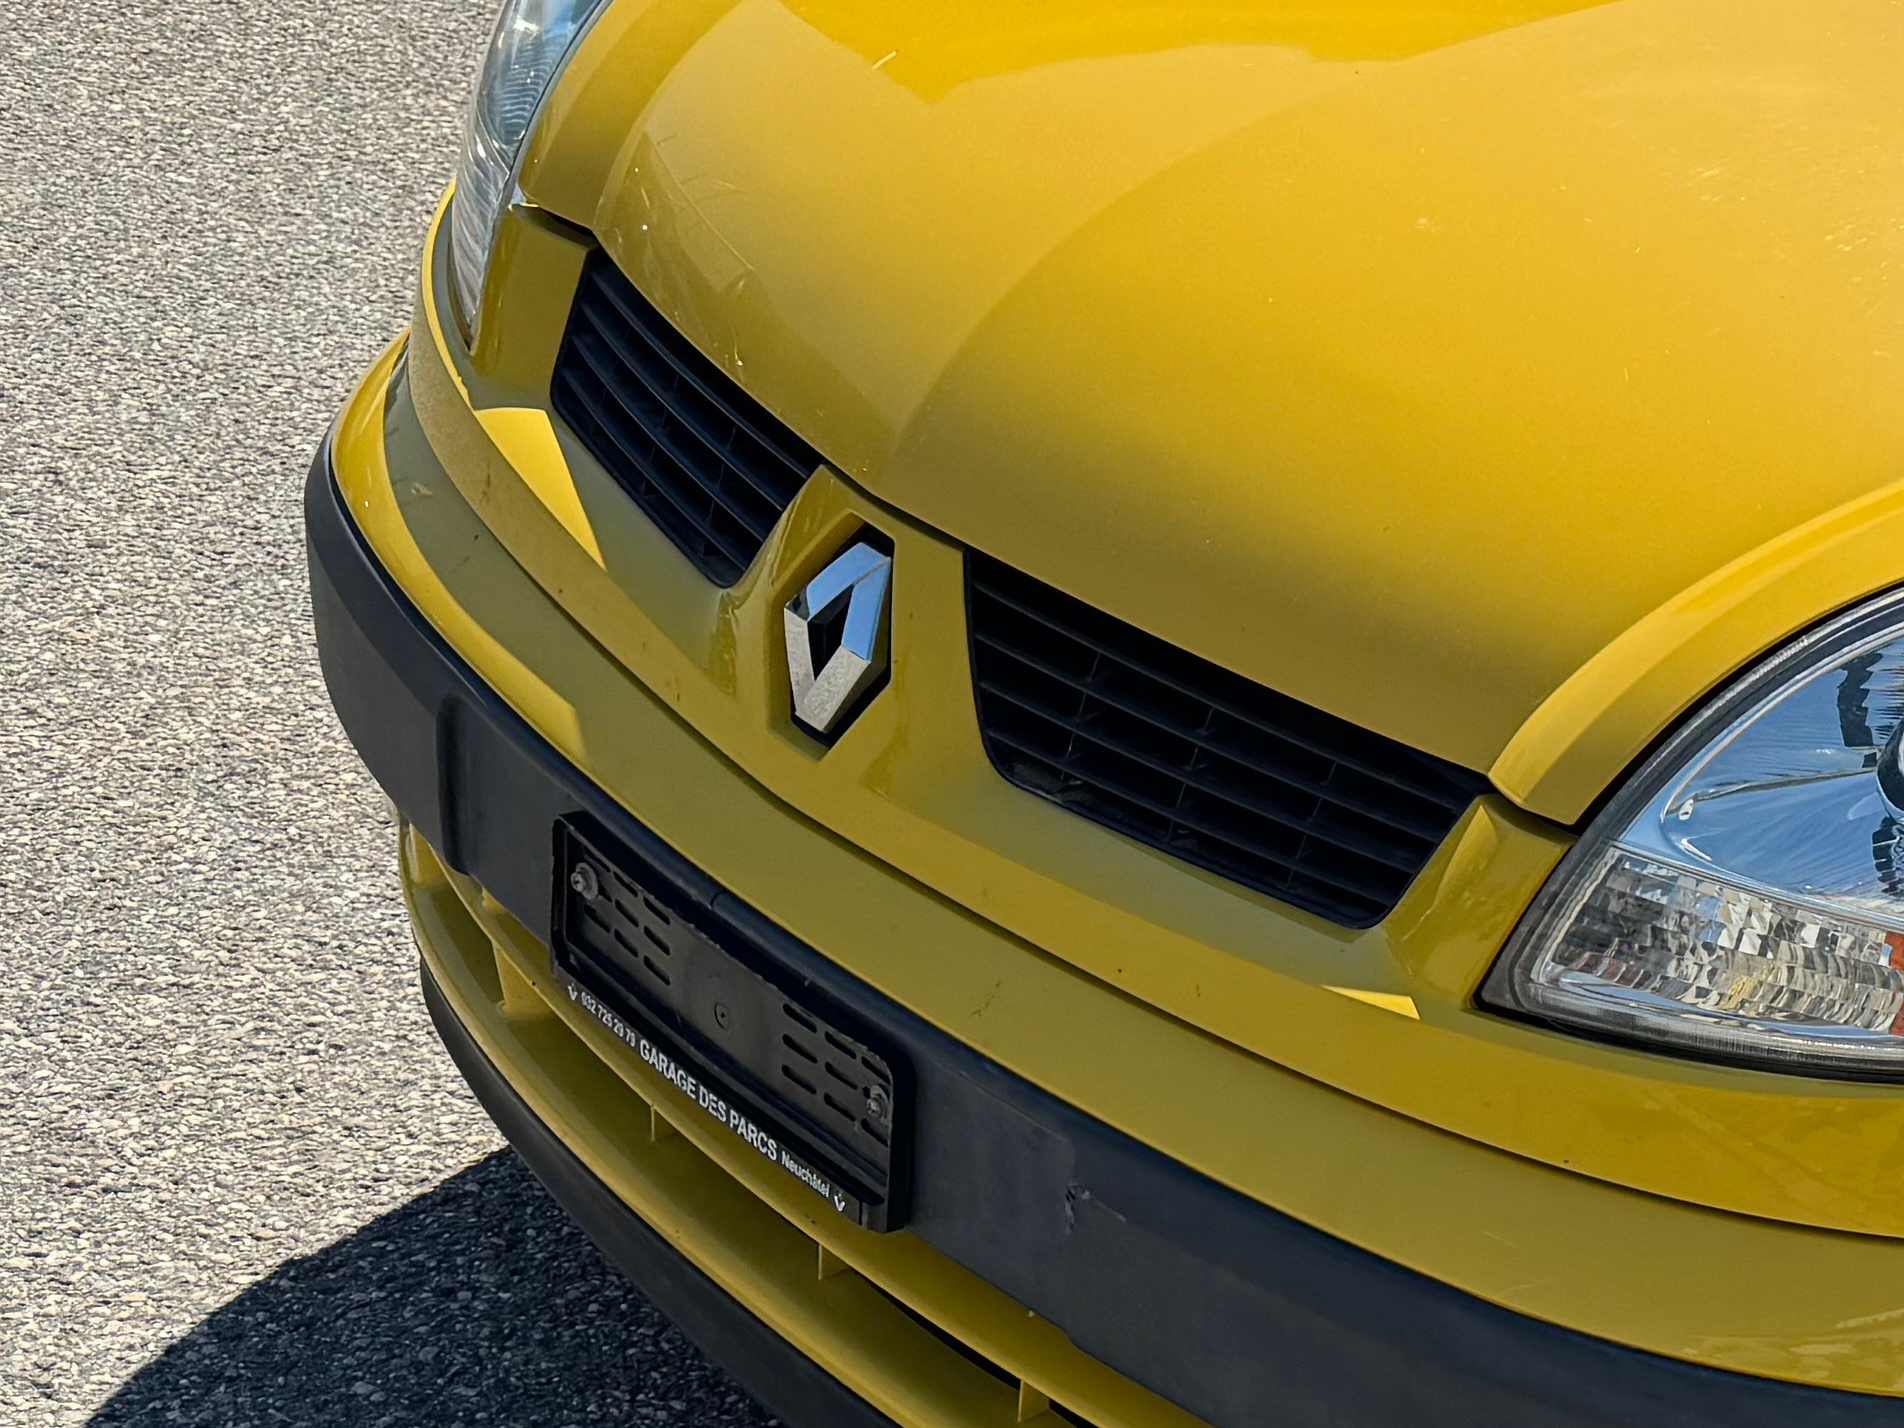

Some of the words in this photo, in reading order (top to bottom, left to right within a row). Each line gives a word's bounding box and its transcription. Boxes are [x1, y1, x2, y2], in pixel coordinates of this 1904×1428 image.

[640, 1039, 696, 1099] GARAGE
[699, 1085, 727, 1122] DES
[729, 1109, 777, 1160] PARCS
[781, 1150, 830, 1198] Neuchâtel
